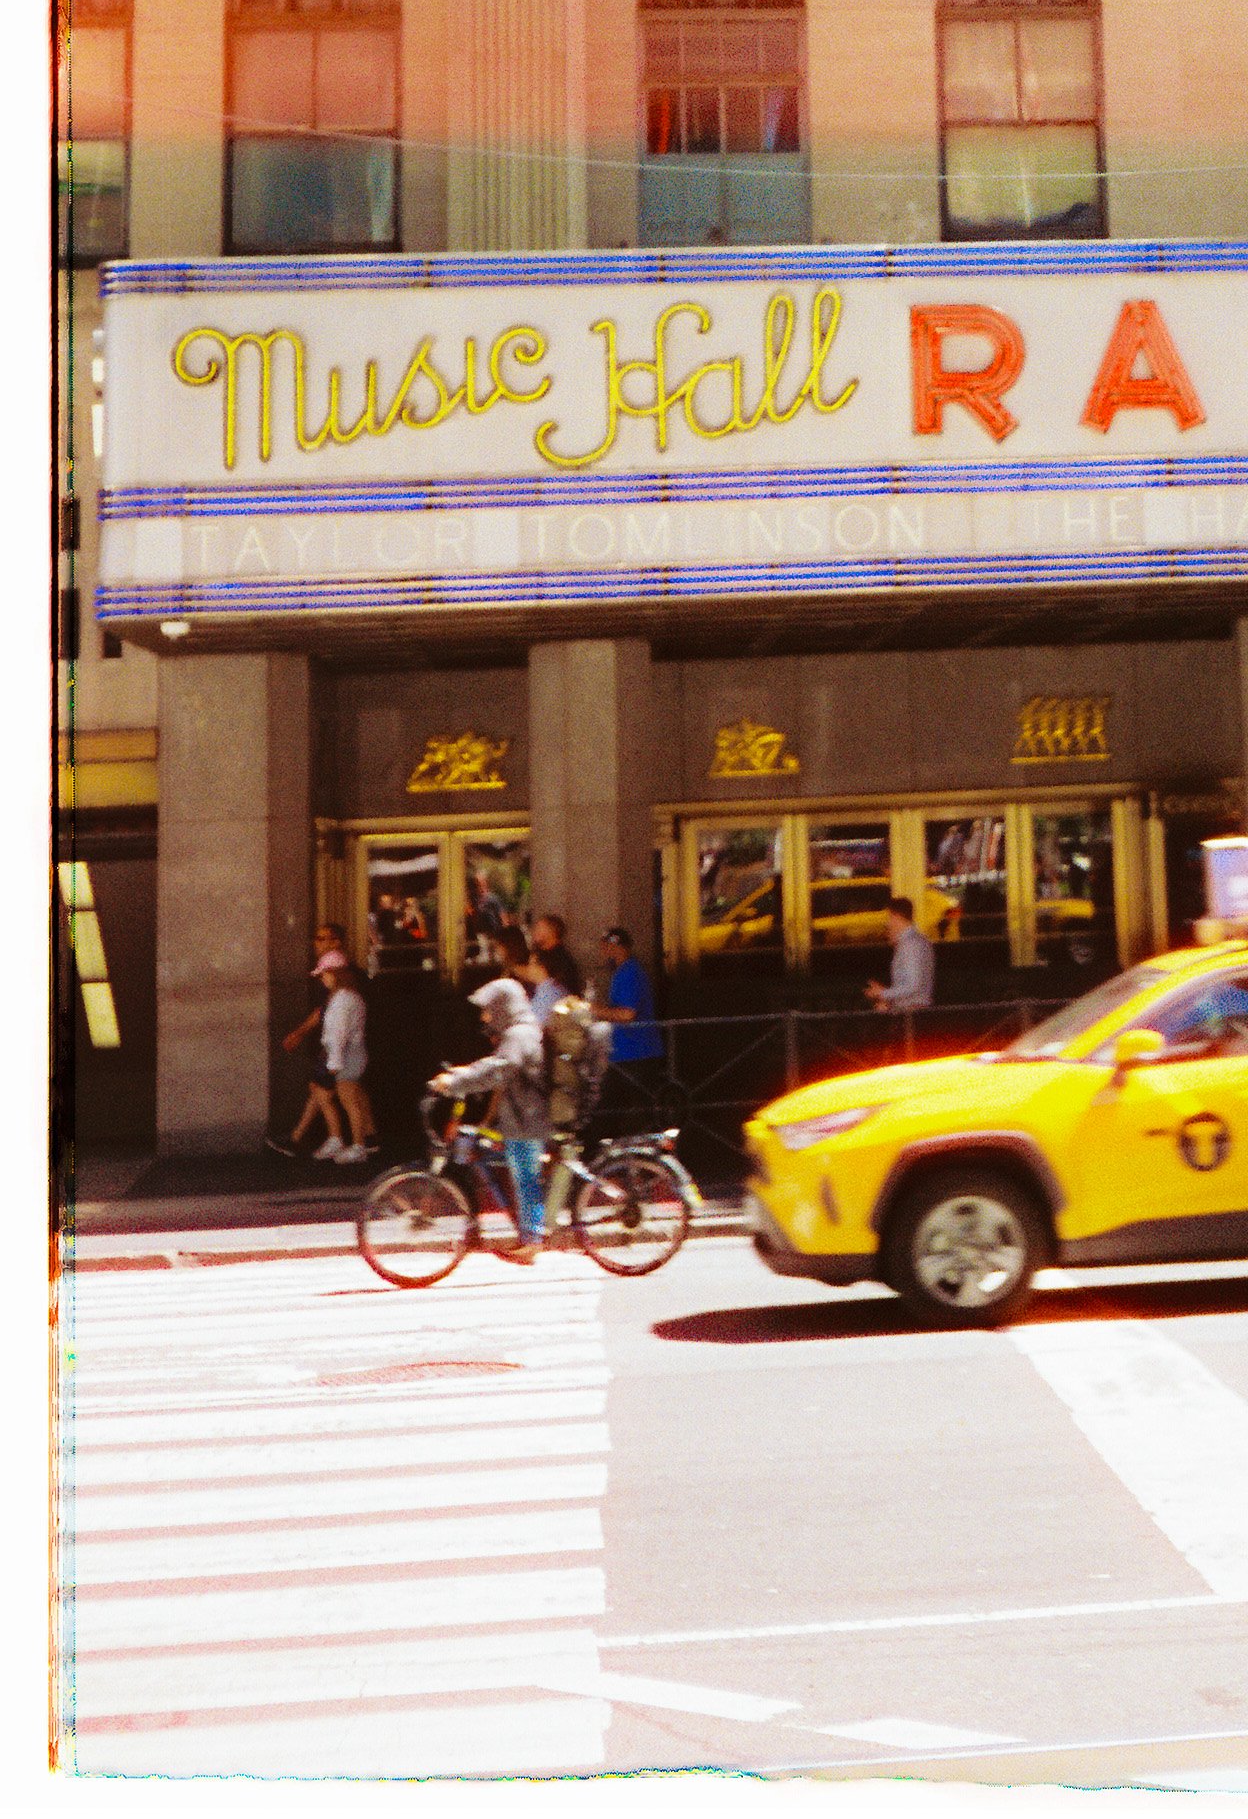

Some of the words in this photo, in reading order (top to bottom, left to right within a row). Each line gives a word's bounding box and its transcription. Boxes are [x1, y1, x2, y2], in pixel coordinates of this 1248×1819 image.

[536, 289, 860, 469] Hall
[189, 518, 468, 574] TAYLOR
[526, 500, 926, 561] TOMLINSON
[1024, 495, 1139, 546] THE
